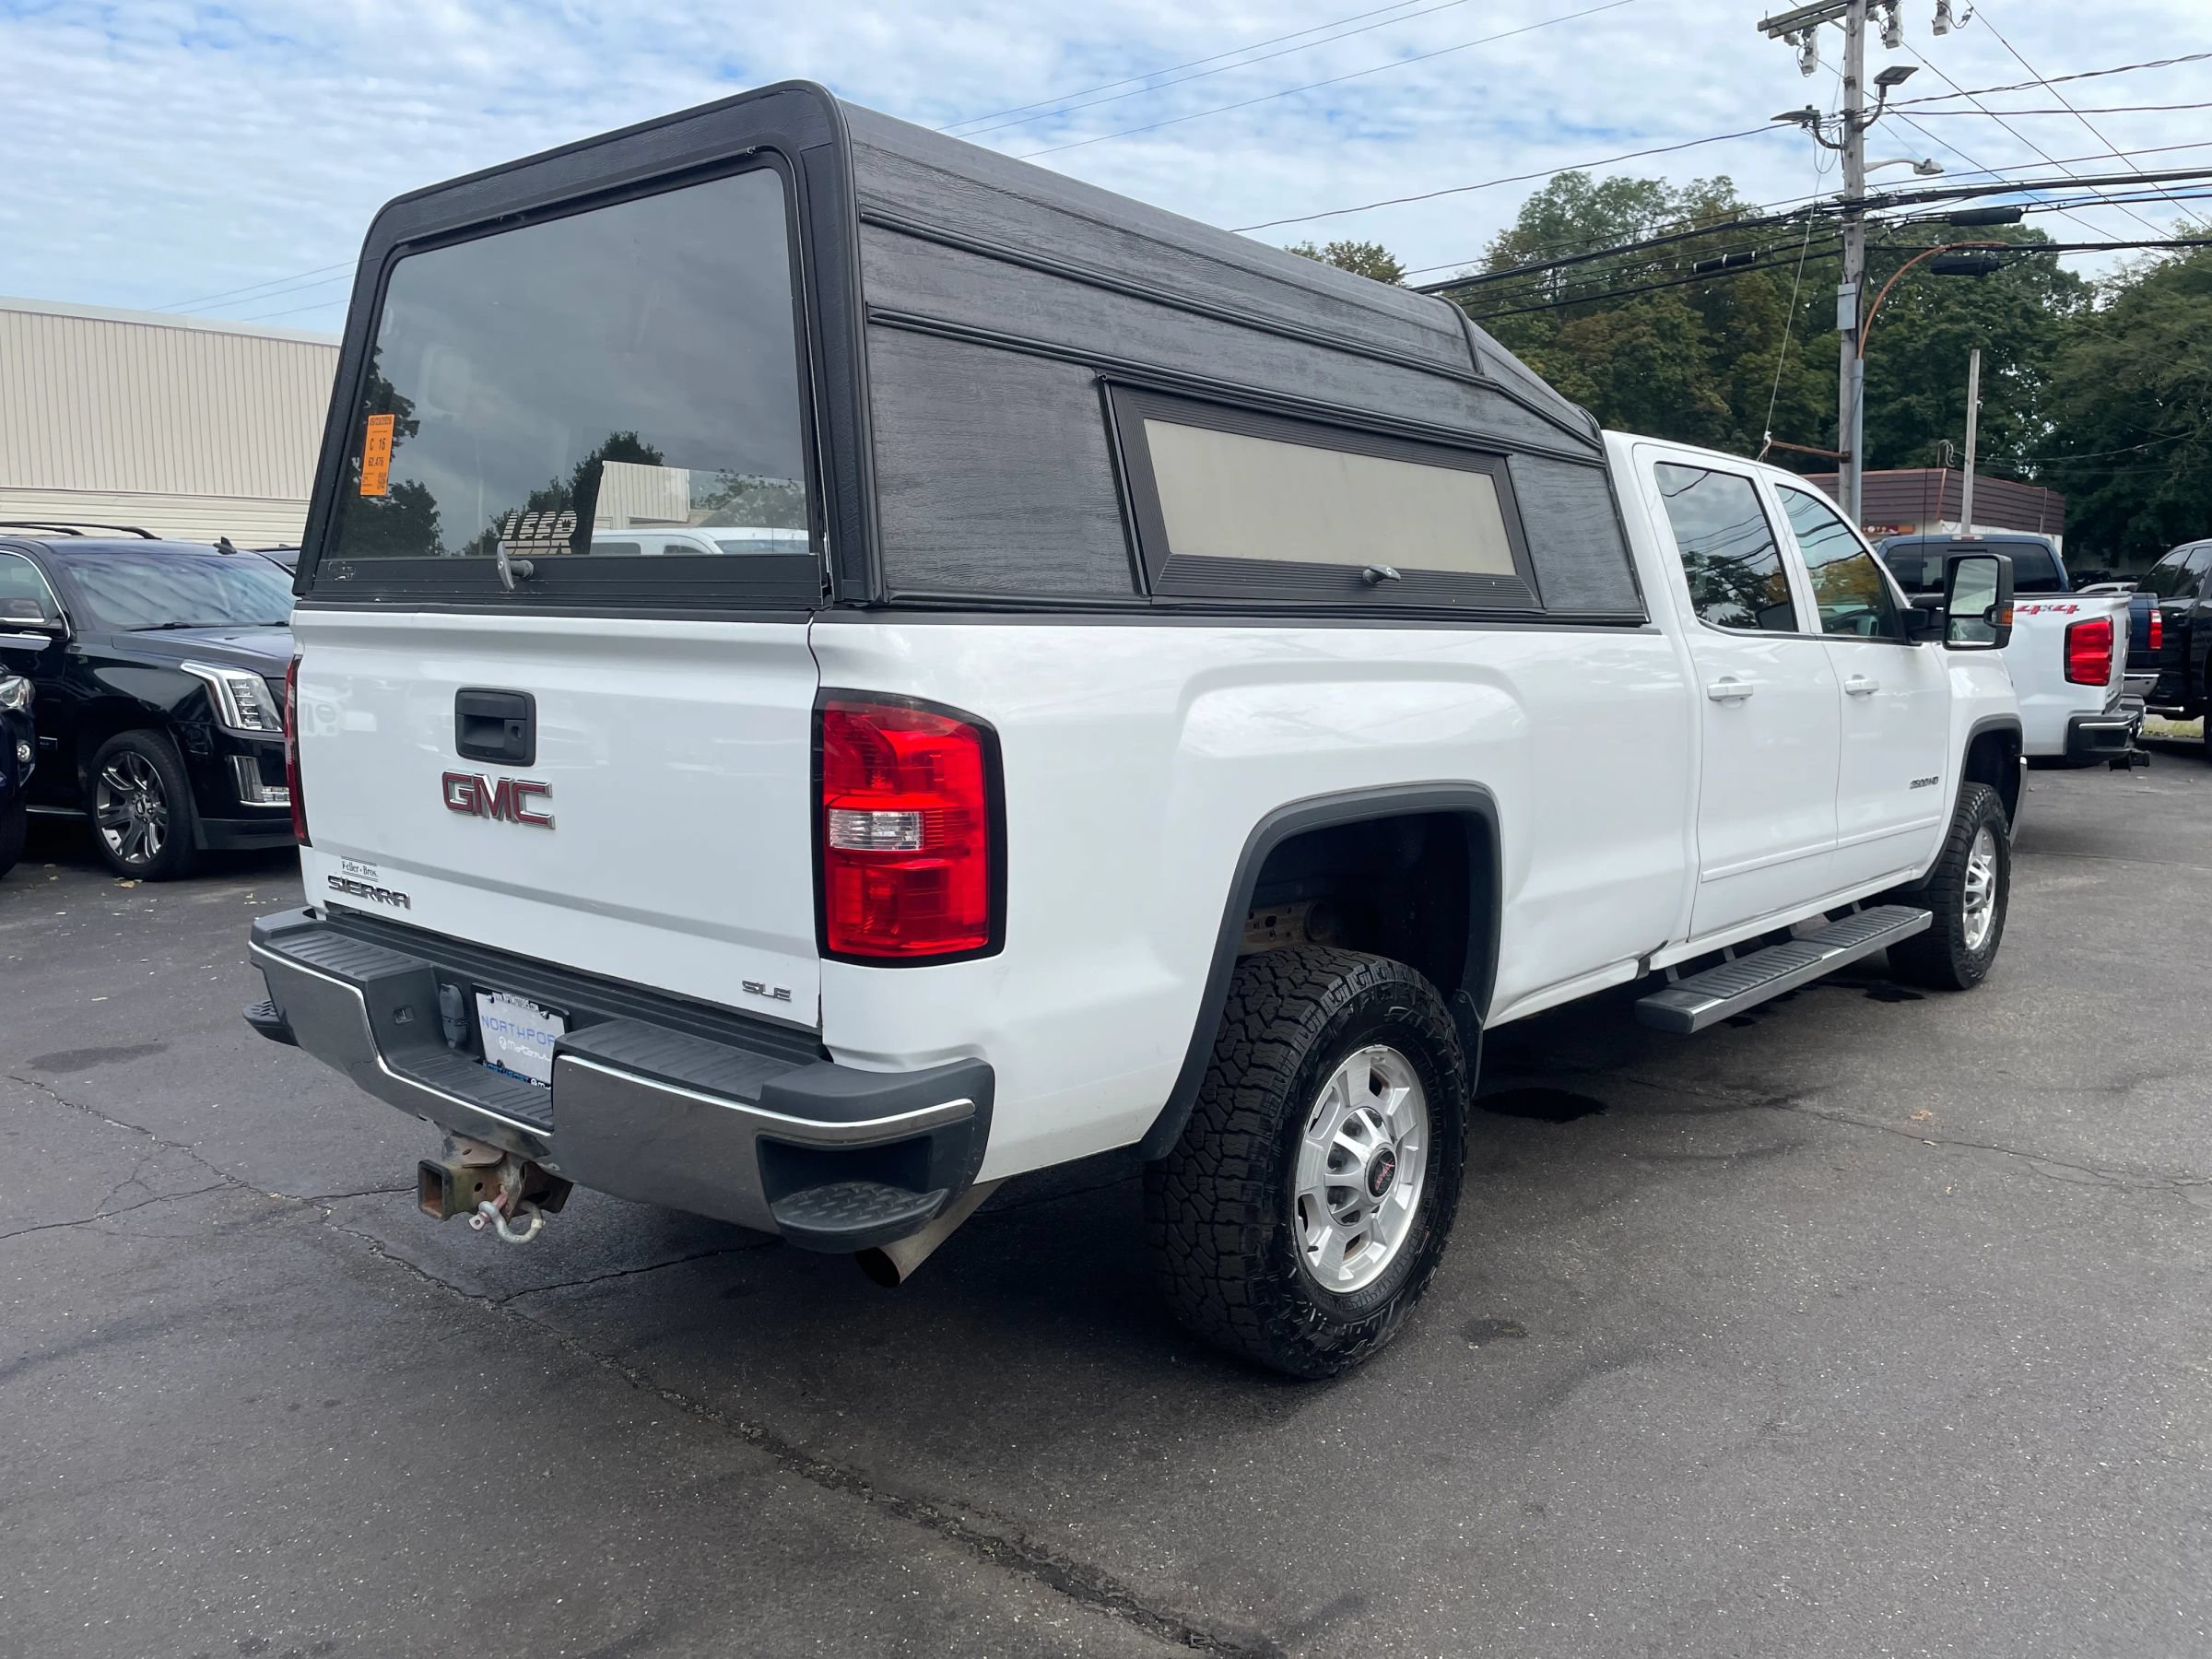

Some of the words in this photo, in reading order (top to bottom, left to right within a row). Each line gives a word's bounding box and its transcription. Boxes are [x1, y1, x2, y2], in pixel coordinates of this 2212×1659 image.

[441, 769, 556, 830] GMC
[327, 874, 411, 911] SIERRA
[742, 979, 792, 1003] SLE
